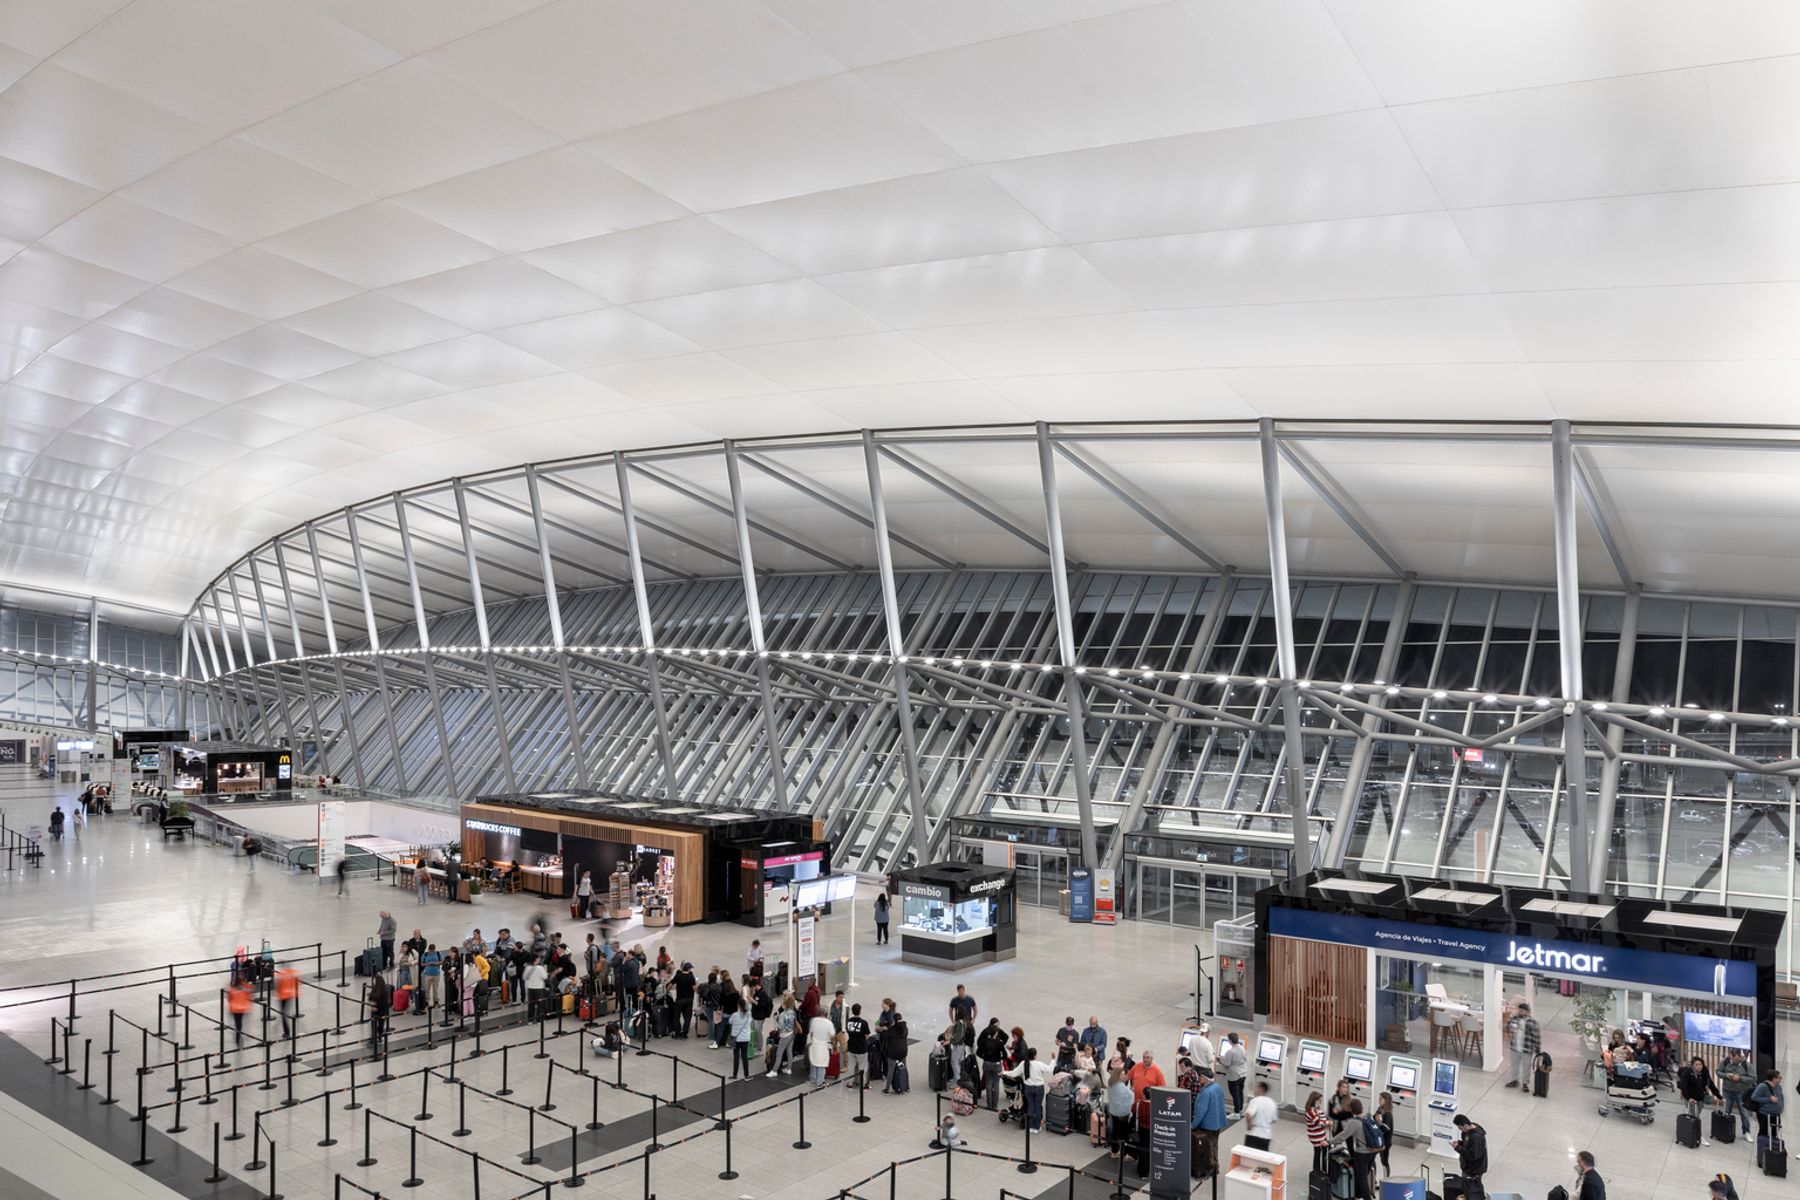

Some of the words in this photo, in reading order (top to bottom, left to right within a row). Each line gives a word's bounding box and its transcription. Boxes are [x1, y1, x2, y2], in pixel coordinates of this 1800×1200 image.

[466, 819, 499, 833] STARBUCKS
[499, 825, 521, 836] COFFEE
[905, 885, 942, 897] cambio
[970, 879, 1006, 893] exchange
[1375, 931, 1401, 940] Agencia
[1412, 936, 1432, 944] Viajes
[1438, 938, 1458, 947] Travel
[1459, 942, 1486, 951] Agency
[1506, 940, 1604, 972] Jetmar
[1154, 1123, 1176, 1132] Check-in
